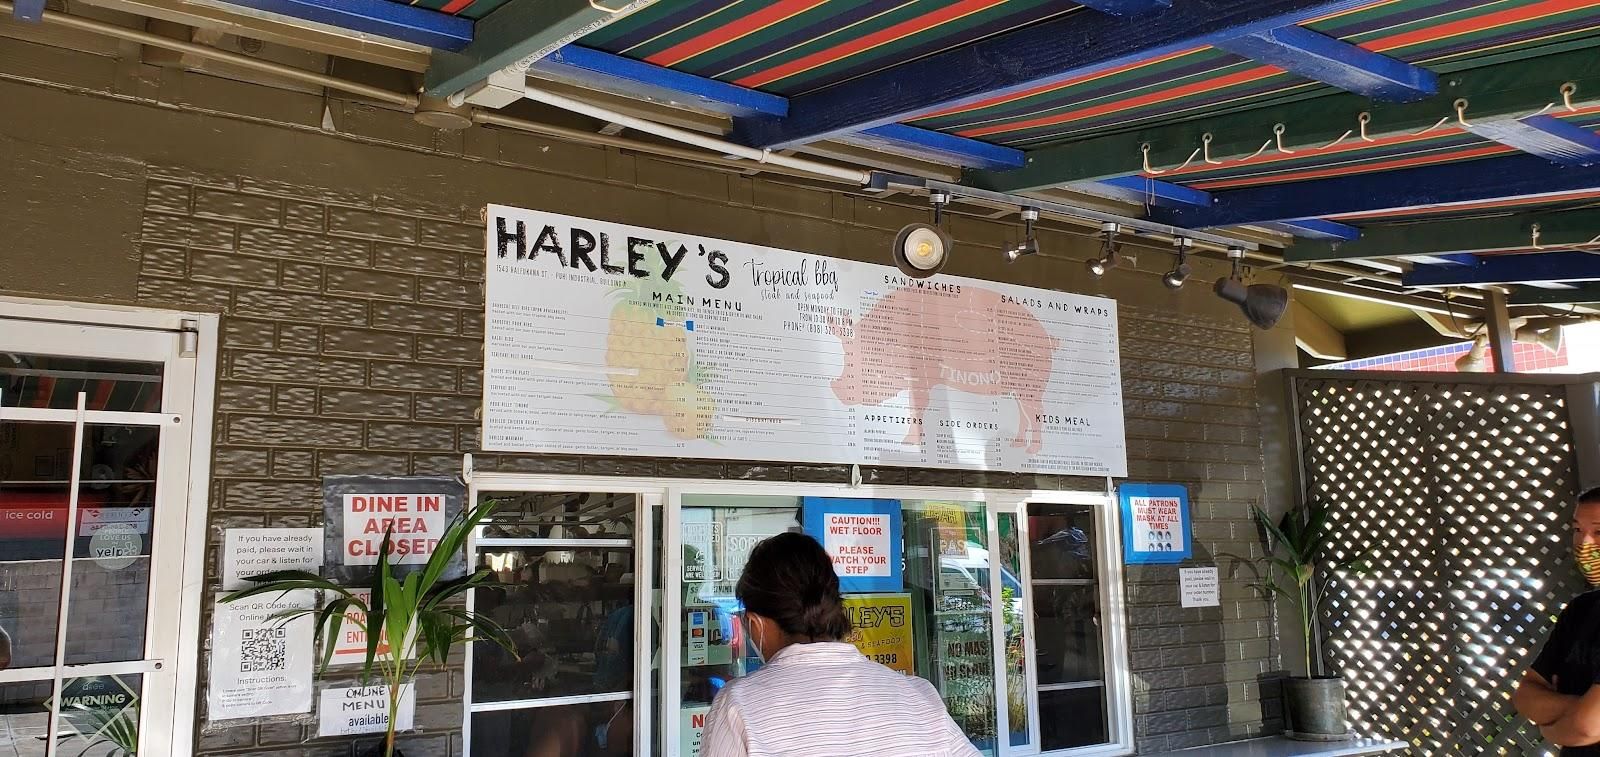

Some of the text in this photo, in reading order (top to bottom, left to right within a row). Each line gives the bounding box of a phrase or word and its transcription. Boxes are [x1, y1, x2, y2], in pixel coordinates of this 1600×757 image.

[495, 216, 731, 290] HARLEY'S
[743, 258, 838, 292] tropical bbq
[884, 274, 962, 294] SANDWICHES
[760, 288, 781, 301] steak
[786, 288, 800, 300] and
[652, 292, 695, 306] MAIN
[702, 298, 742, 312] MENU
[1001, 294, 1109, 318] SALADS AND WRAPS
[938, 362, 1001, 386] TINONO
[864, 414, 923, 426] APPETIZERS
[939, 420, 1000, 430] SIDE ORDERS
[1035, 414, 1090, 427] KIDS MEAL
[351, 496, 440, 512] DINE IN
[1134, 499, 1178, 508] ALL PATRONS
[6, 510, 54, 520] ice cold
[1158, 507, 1177, 515] WEAR
[363, 518, 428, 534] AREA
[831, 516, 880, 525] CAUTION!!!
[830, 526, 882, 535] WET FLOOR
[245, 536, 261, 544] you
[283, 535, 313, 544] already
[96, 546, 124, 558] yelp
[236, 546, 258, 554] paid,
[259, 546, 289, 554] please
[839, 546, 874, 554] PLEASE
[236, 558, 255, 566] your
[861, 556, 887, 564] YOUR
[236, 570, 255, 578] your
[845, 566, 869, 574] STEP
[964, 640, 988, 656] MAS
[60, 694, 126, 707] WARNING
[342, 700, 385, 712] MENU
[348, 714, 389, 727] available
